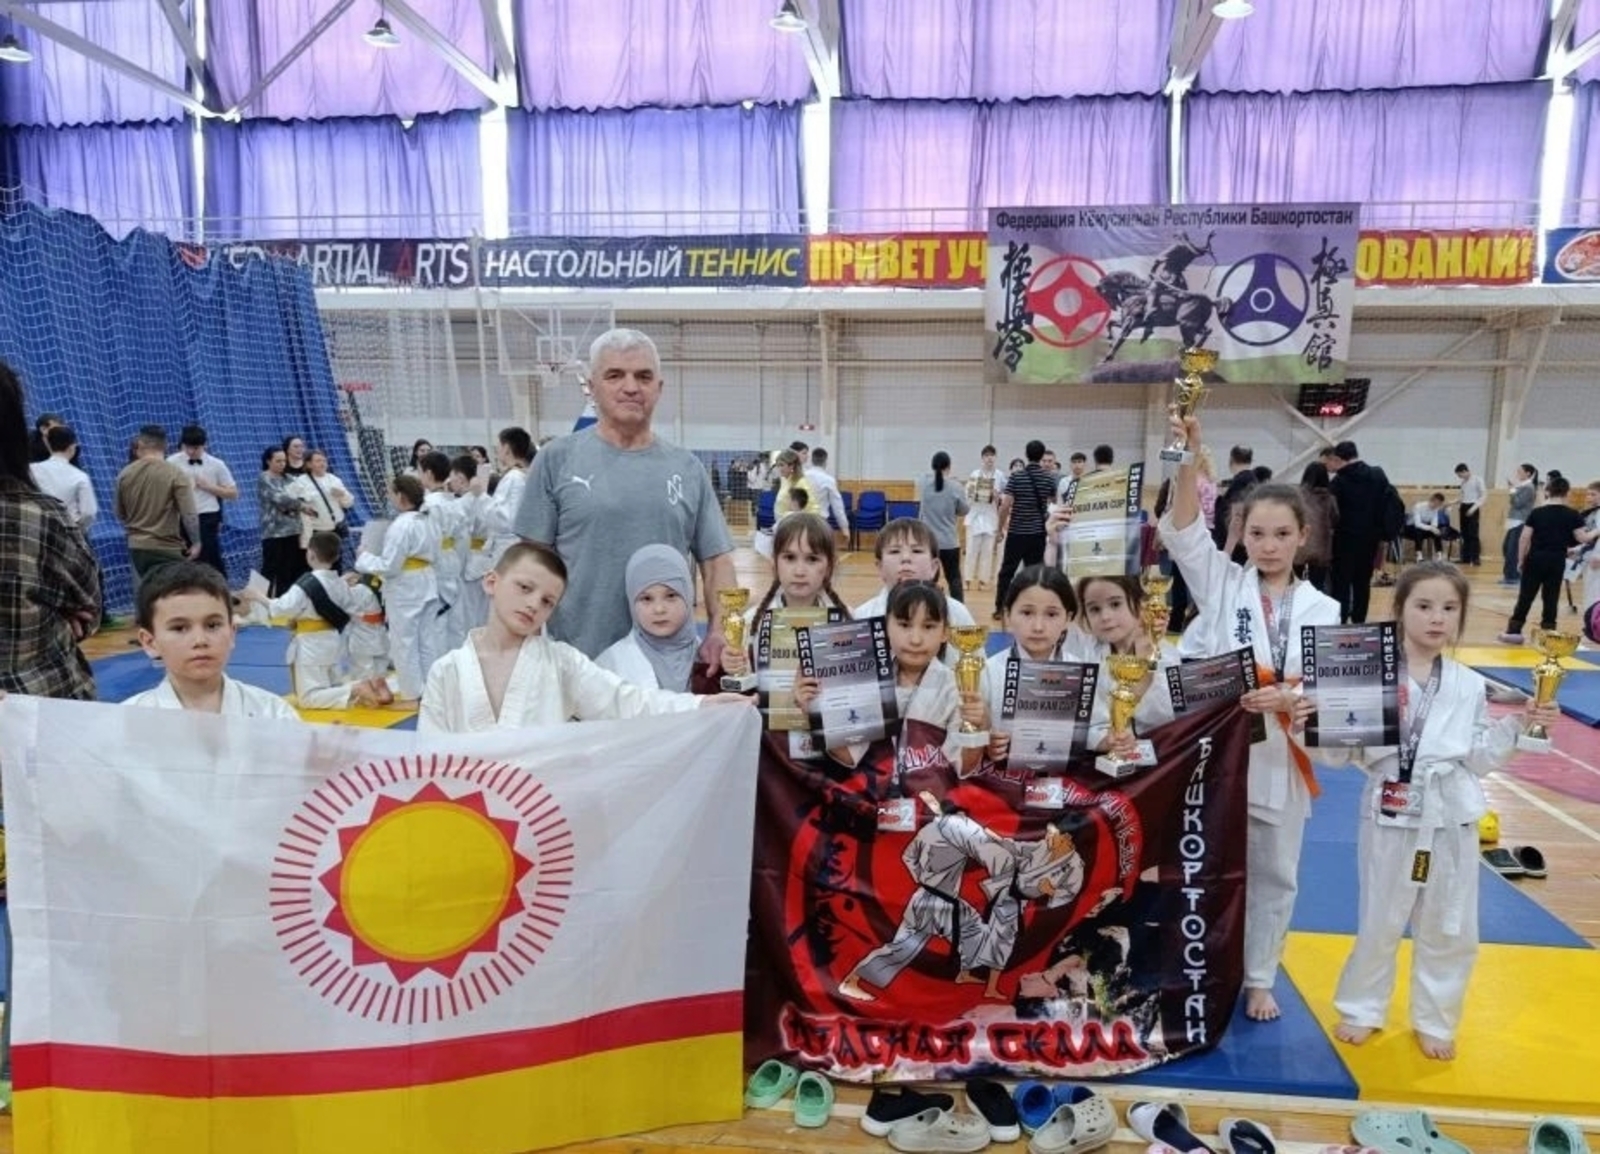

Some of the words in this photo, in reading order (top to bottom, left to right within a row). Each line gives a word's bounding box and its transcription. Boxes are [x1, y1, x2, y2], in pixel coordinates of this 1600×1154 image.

[996, 211, 1075, 231] Федерация
[1164, 208, 1247, 228] Республики
[1251, 207, 1354, 228] Башкортостан
[485, 246, 682, 280] НАСТОЛЬНЫЙ
[687, 247, 800, 279] ТЕННИС
[810, 239, 941, 281] ПРИВЕТ
[1302, 629, 1314, 682] ДИПЛОМ
[1003, 661, 1018, 714] ДИПЛОМ
[1180, 737, 1213, 1045] БАШКОРТОСТАН
[987, 1019, 1148, 1067] СКАЛА
